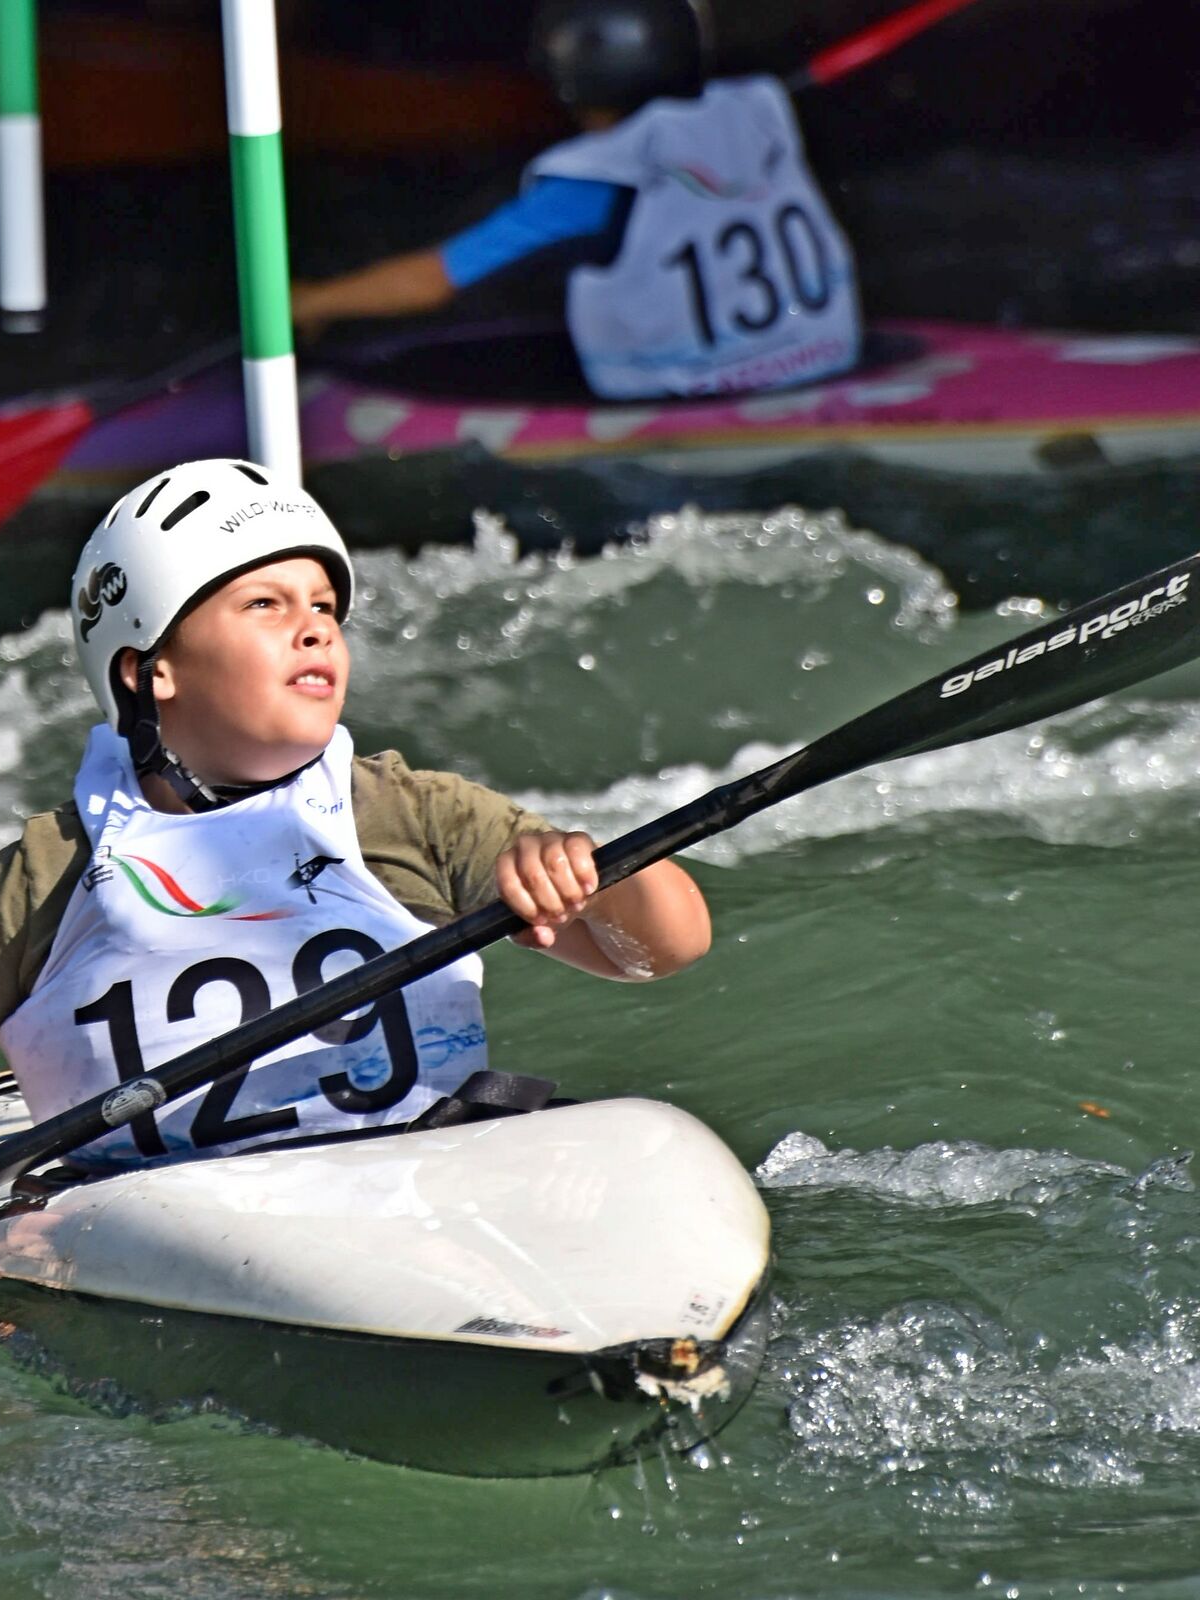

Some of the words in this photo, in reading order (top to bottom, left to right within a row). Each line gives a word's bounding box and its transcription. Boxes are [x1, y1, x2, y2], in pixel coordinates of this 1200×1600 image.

[662, 203, 831, 348] 130
[939, 572, 1191, 699] galasport
[74, 928, 419, 1158] 129
